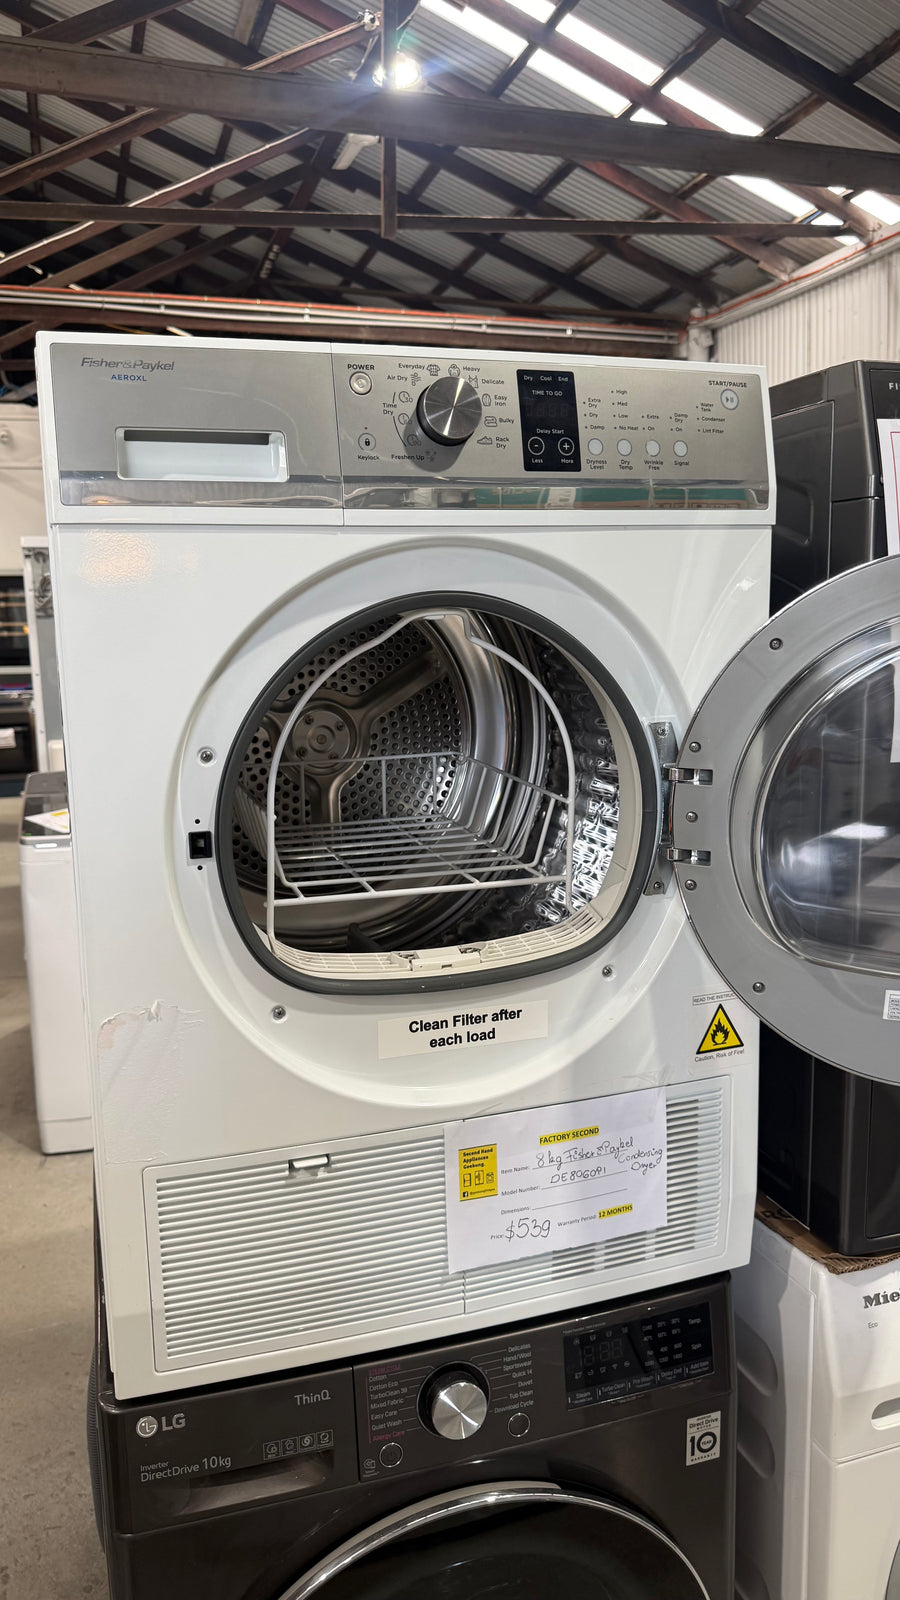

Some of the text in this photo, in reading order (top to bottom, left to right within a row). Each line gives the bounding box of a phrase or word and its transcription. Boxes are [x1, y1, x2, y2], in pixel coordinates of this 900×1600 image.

[347, 363, 375, 371] POWER
[708, 380, 748, 388] START/PAUSE
[888, 382, 900, 391] FI
[409, 1009, 523, 1033] Clean Filter after
[429, 1028, 496, 1048] each load
[539, 1127, 600, 1145] FACTORY SECOND
[536, 1153, 545, 1168] 8
[548, 1150, 563, 1171] kg
[618, 1148, 663, 1164] Condensing
[513, 1165, 529, 1173] Name:
[519, 1185, 540, 1193] Number:
[501, 1206, 531, 1215] Dimensions:
[599, 1204, 633, 1218] 12 MONTHS
[557, 1217, 580, 1227] Warranty
[505, 1217, 551, 1242] $539
[862, 1288, 900, 1308] Mie
[508, 1343, 531, 1352] Delicates
[503, 1352, 532, 1362] Hand/Wool
[503, 1361, 532, 1371] Sportswear
[368, 1374, 387, 1382] Cotton
[512, 1371, 526, 1379] Quick
[369, 1384, 387, 1392] Cotton
[518, 1379, 533, 1387] Duvet
[294, 1390, 331, 1406] ThinQ
[519, 1389, 533, 1397] Clean
[371, 1398, 404, 1409] Mixed Fabric
[494, 1399, 534, 1413] Download Cycle
[371, 1410, 397, 1420] Easy Care
[161, 1413, 186, 1431] LG
[372, 1419, 402, 1431] Quiet Wash
[689, 1420, 704, 1429] Direct
[705, 1417, 719, 1425] Drive
[690, 1431, 717, 1457] 10
[140, 1461, 169, 1472] Inverter
